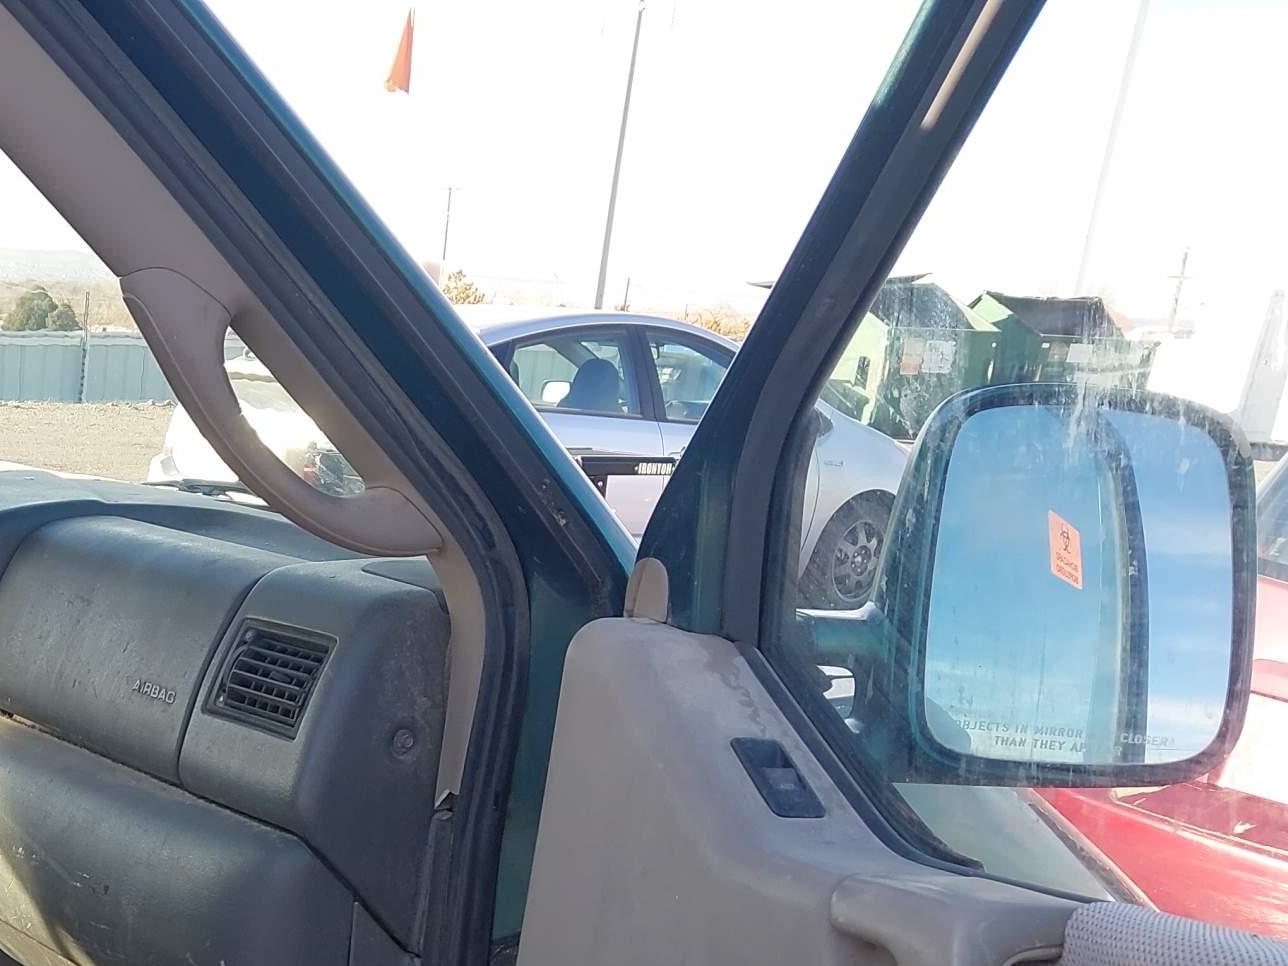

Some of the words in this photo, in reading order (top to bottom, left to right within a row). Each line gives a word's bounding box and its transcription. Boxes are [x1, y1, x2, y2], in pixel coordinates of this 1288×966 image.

[132, 680, 175, 704] AIRBAG
[1015, 723, 1028, 734] IN
[1034, 724, 1083, 739] MIRROR
[994, 735, 1025, 748] THAN
[1032, 738, 1065, 752] THEY
